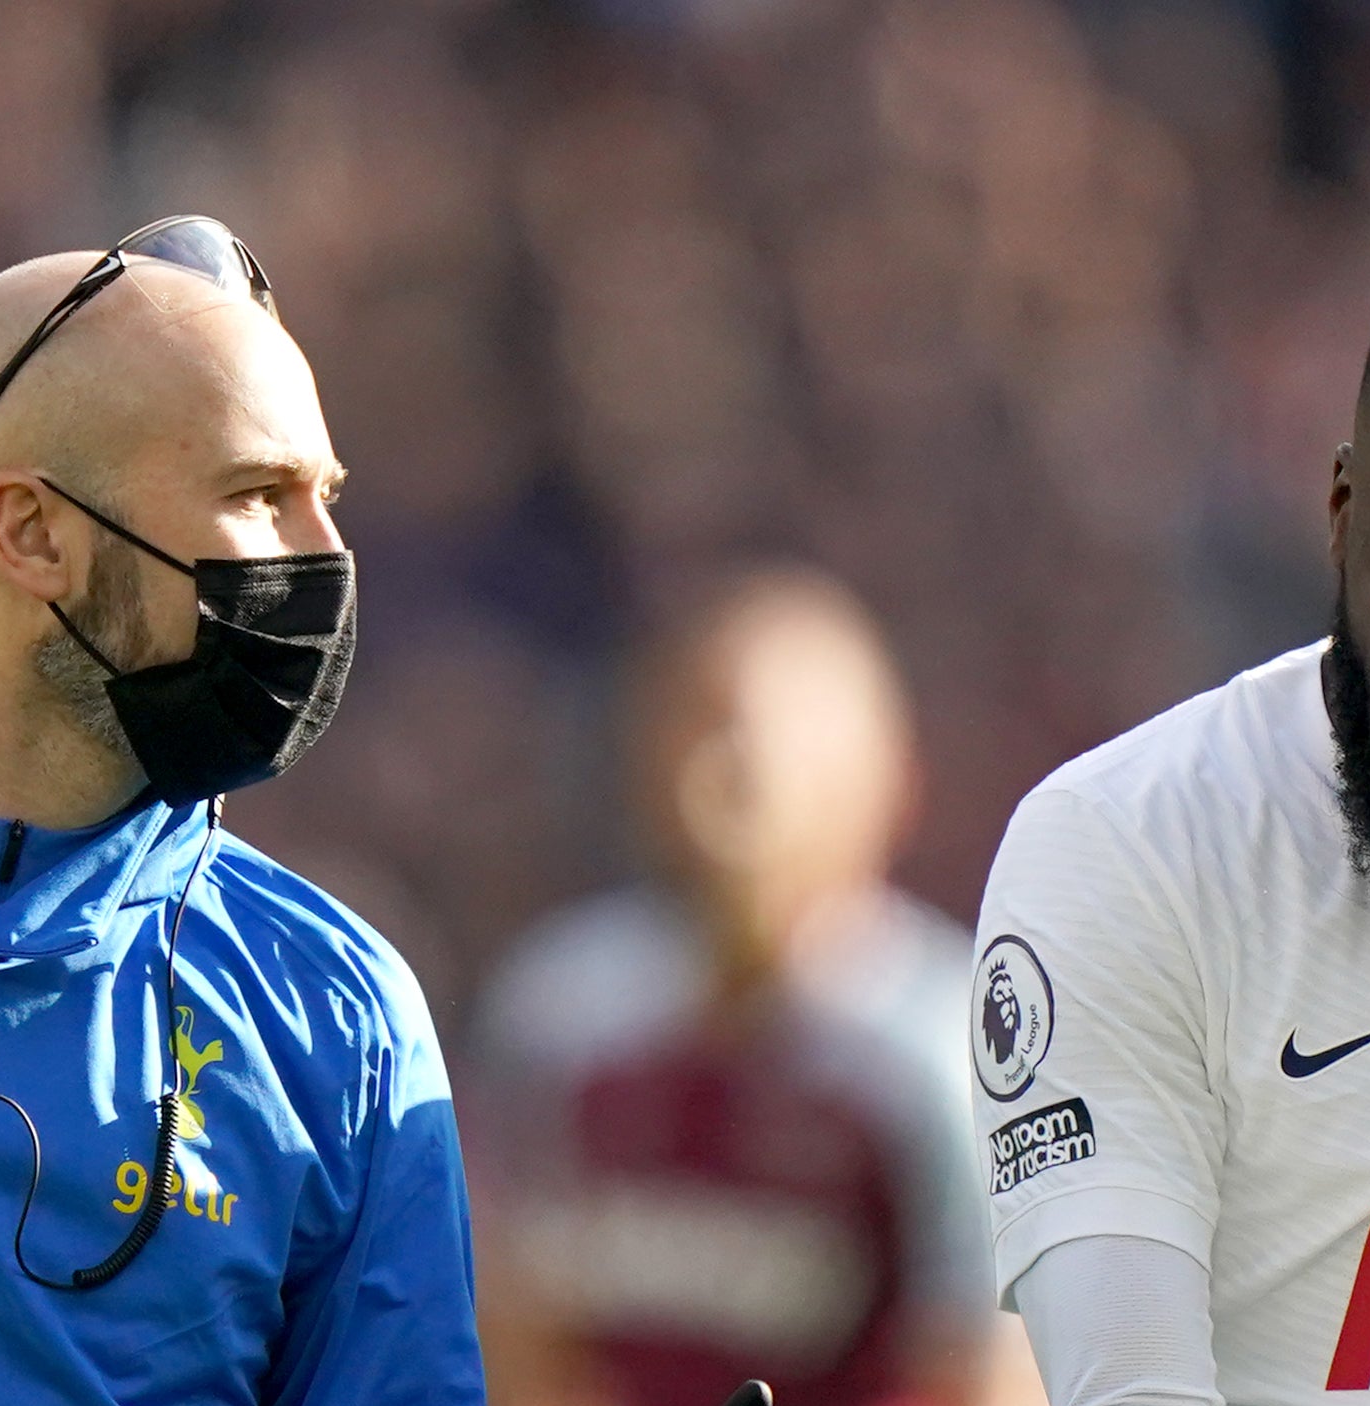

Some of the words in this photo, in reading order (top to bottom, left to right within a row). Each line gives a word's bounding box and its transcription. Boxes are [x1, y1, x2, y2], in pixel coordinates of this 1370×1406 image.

[1020, 1004, 1041, 1055] League
[990, 1131, 1014, 1165] No
[1011, 1108, 1078, 1153] room
[1018, 1132, 1095, 1181] racism
